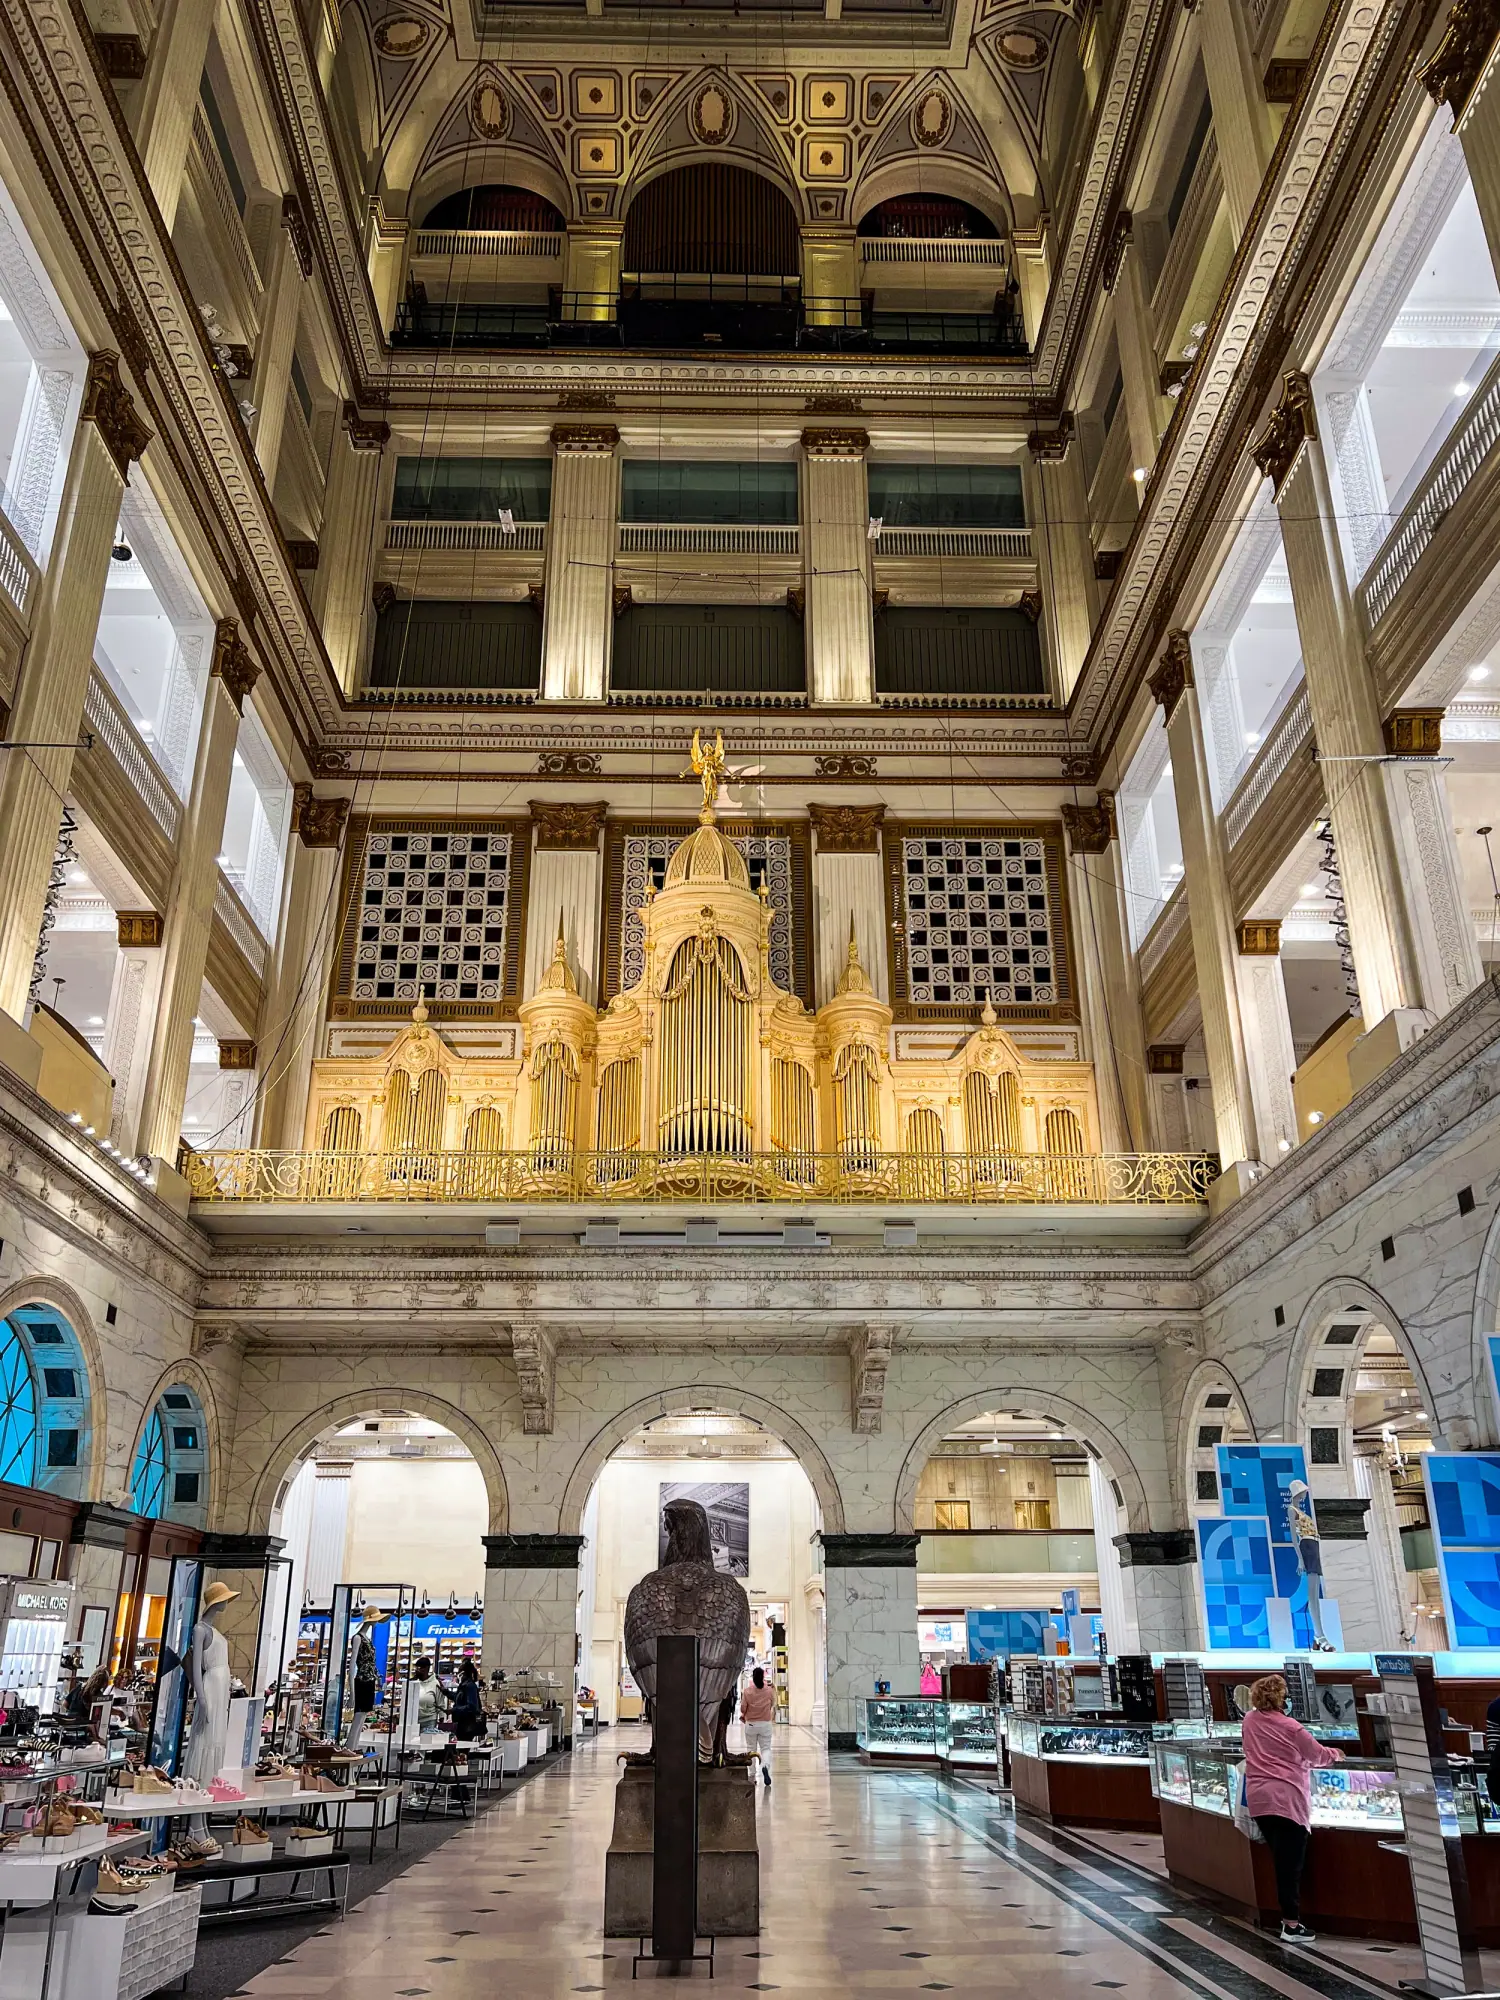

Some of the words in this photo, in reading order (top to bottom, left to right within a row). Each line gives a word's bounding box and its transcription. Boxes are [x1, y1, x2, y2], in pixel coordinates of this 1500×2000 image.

[17, 1593, 48, 1609] MICHAEL
[50, 1596, 68, 1611] KORS
[427, 1624, 469, 1635] Finish
[1398, 1659, 1410, 1674] Style
